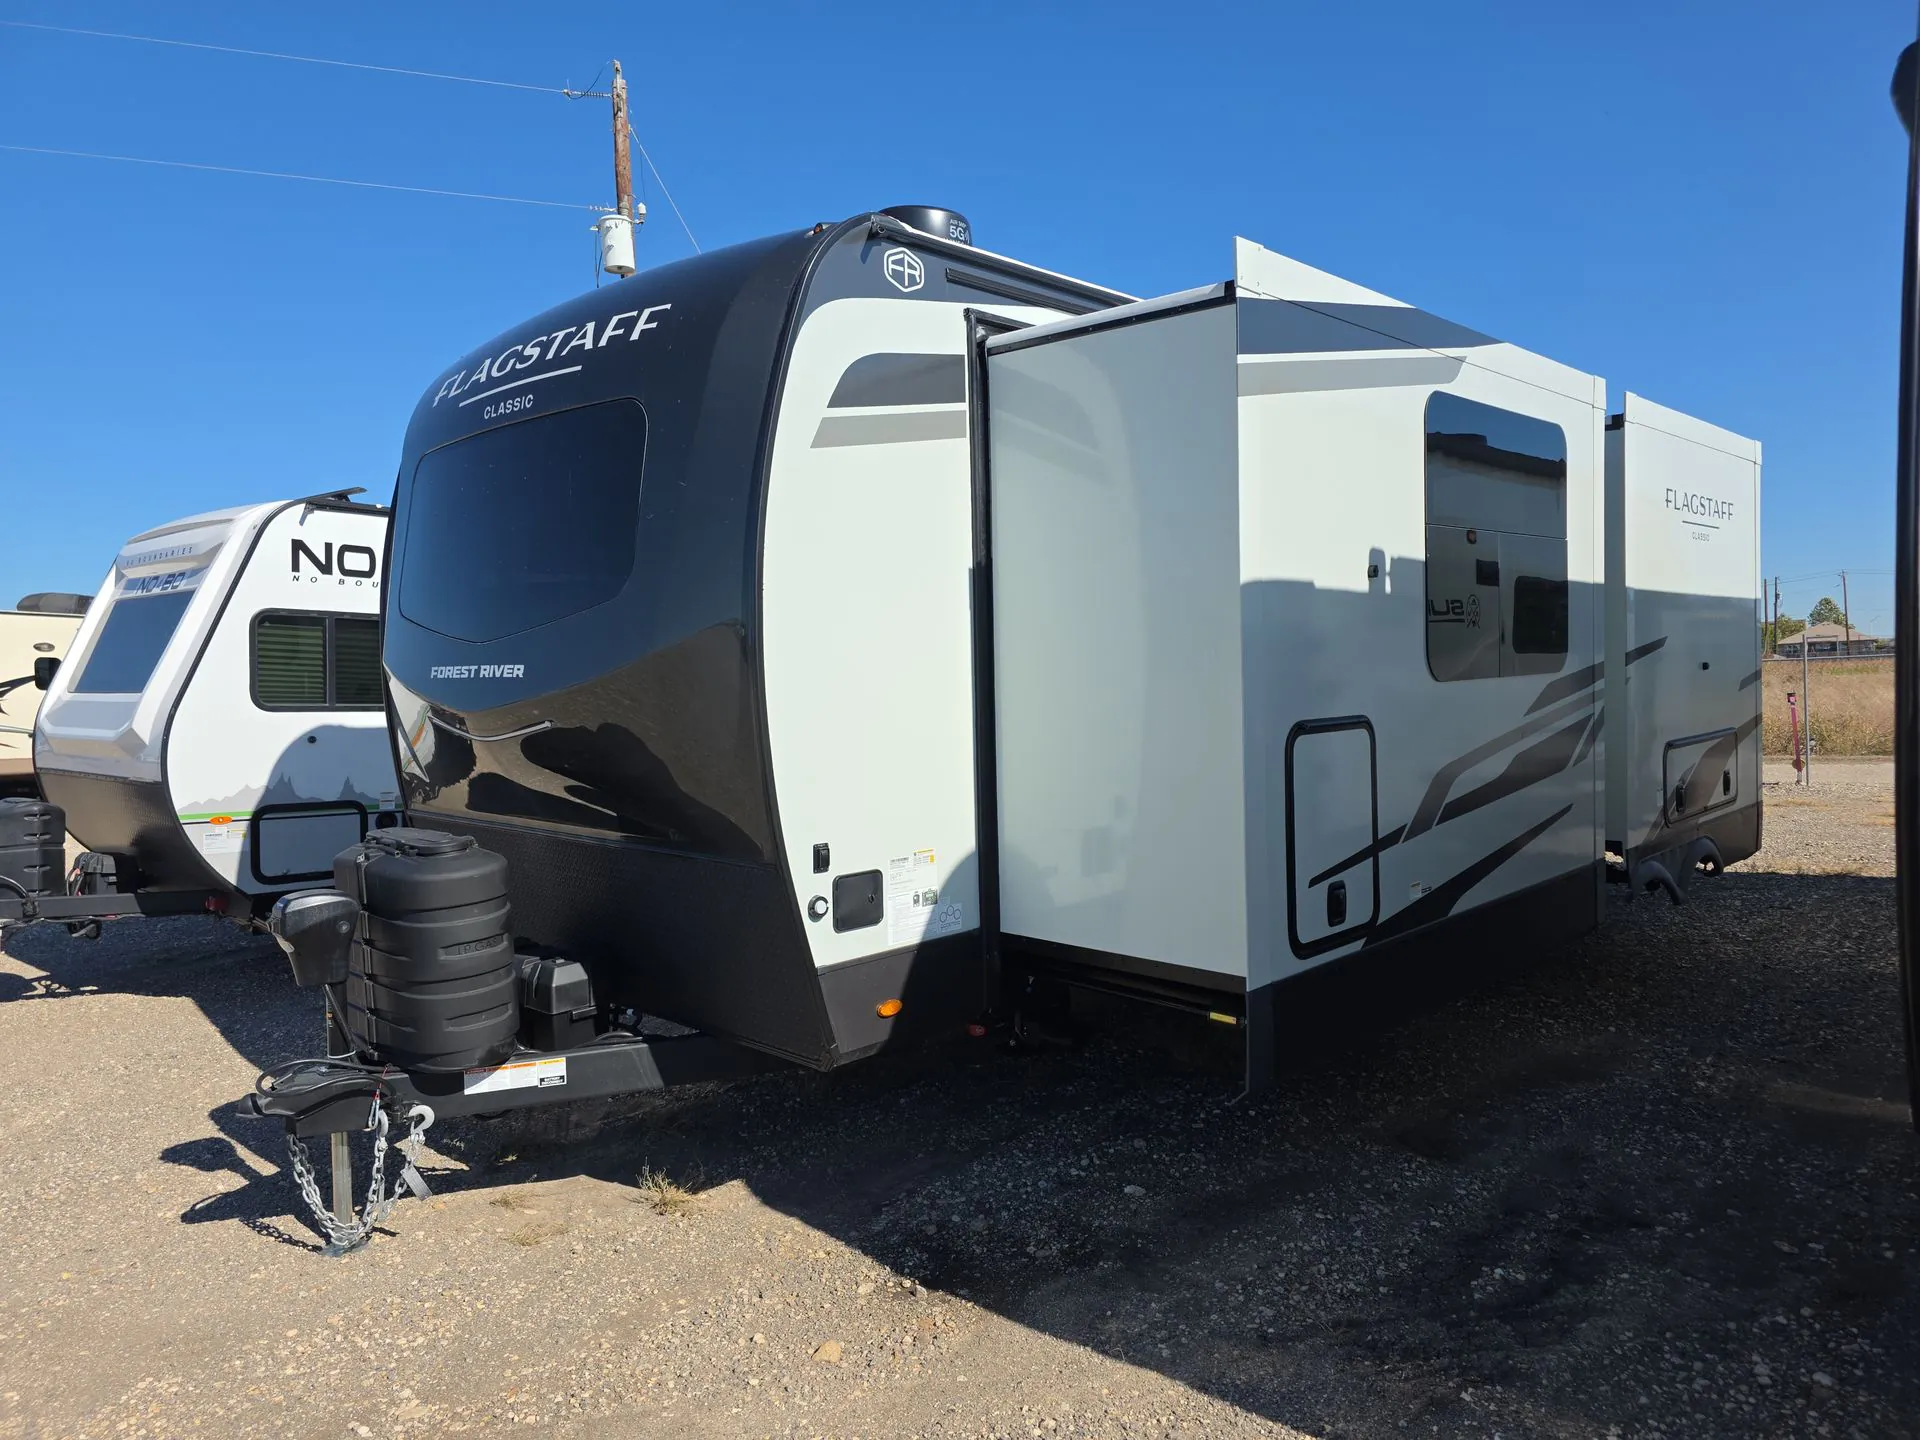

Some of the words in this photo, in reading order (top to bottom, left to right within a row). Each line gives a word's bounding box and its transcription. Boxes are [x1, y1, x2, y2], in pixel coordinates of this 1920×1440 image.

[949, 225, 965, 241] 5G
[432, 303, 672, 408] FLAGSTAFF
[484, 394, 534, 420] CLASSIC
[1665, 488, 1734, 520] FLAGSTAFF
[292, 575, 318, 584] NO
[338, 578, 379, 588] BOU
[430, 665, 478, 679] FOREST
[480, 664, 525, 678] RIVER
